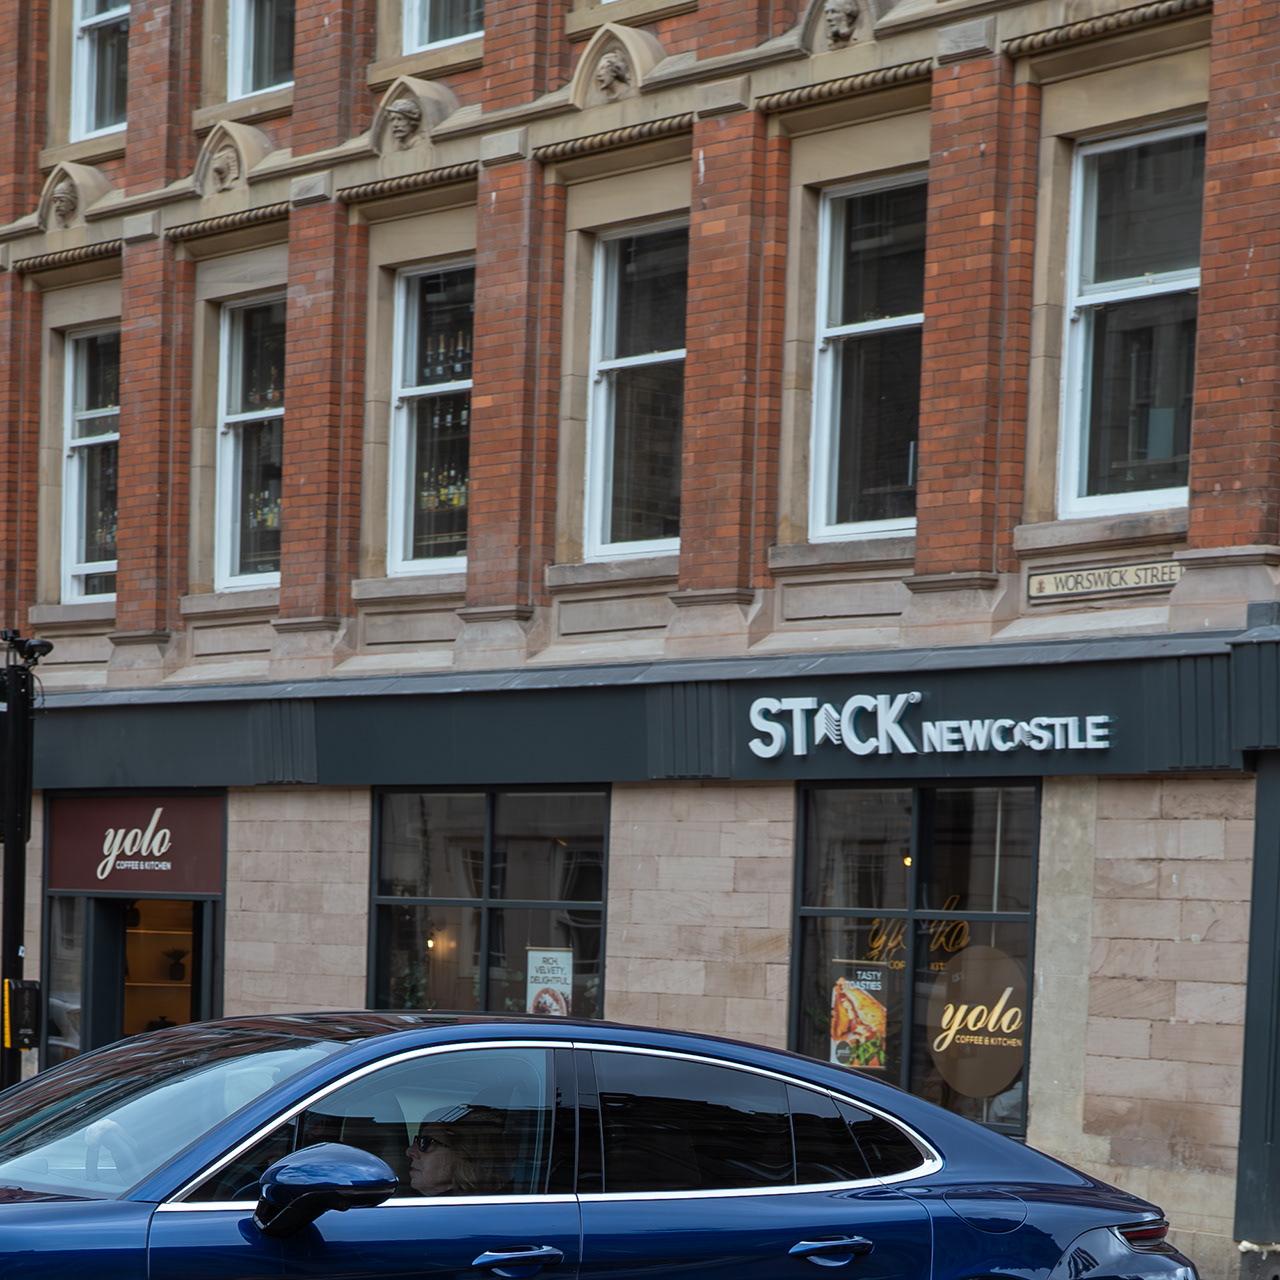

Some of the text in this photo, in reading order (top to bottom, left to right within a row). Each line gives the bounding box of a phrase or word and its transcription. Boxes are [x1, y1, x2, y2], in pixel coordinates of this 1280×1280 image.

[1054, 569, 1128, 591] WORSWICK
[748, 692, 1113, 758] STACK NEWCASTLE
[96, 807, 172, 880] yolo
[115, 860, 139, 870] COFFEE
[145, 861, 172, 870] KITCHEN
[856, 971, 882, 981] TASTY
[845, 980, 882, 991] TOASTIES
[933, 987, 1023, 1052] yolo
[955, 1035, 983, 1045] COFFEE
[990, 1036, 1023, 1046] KITCHEN
